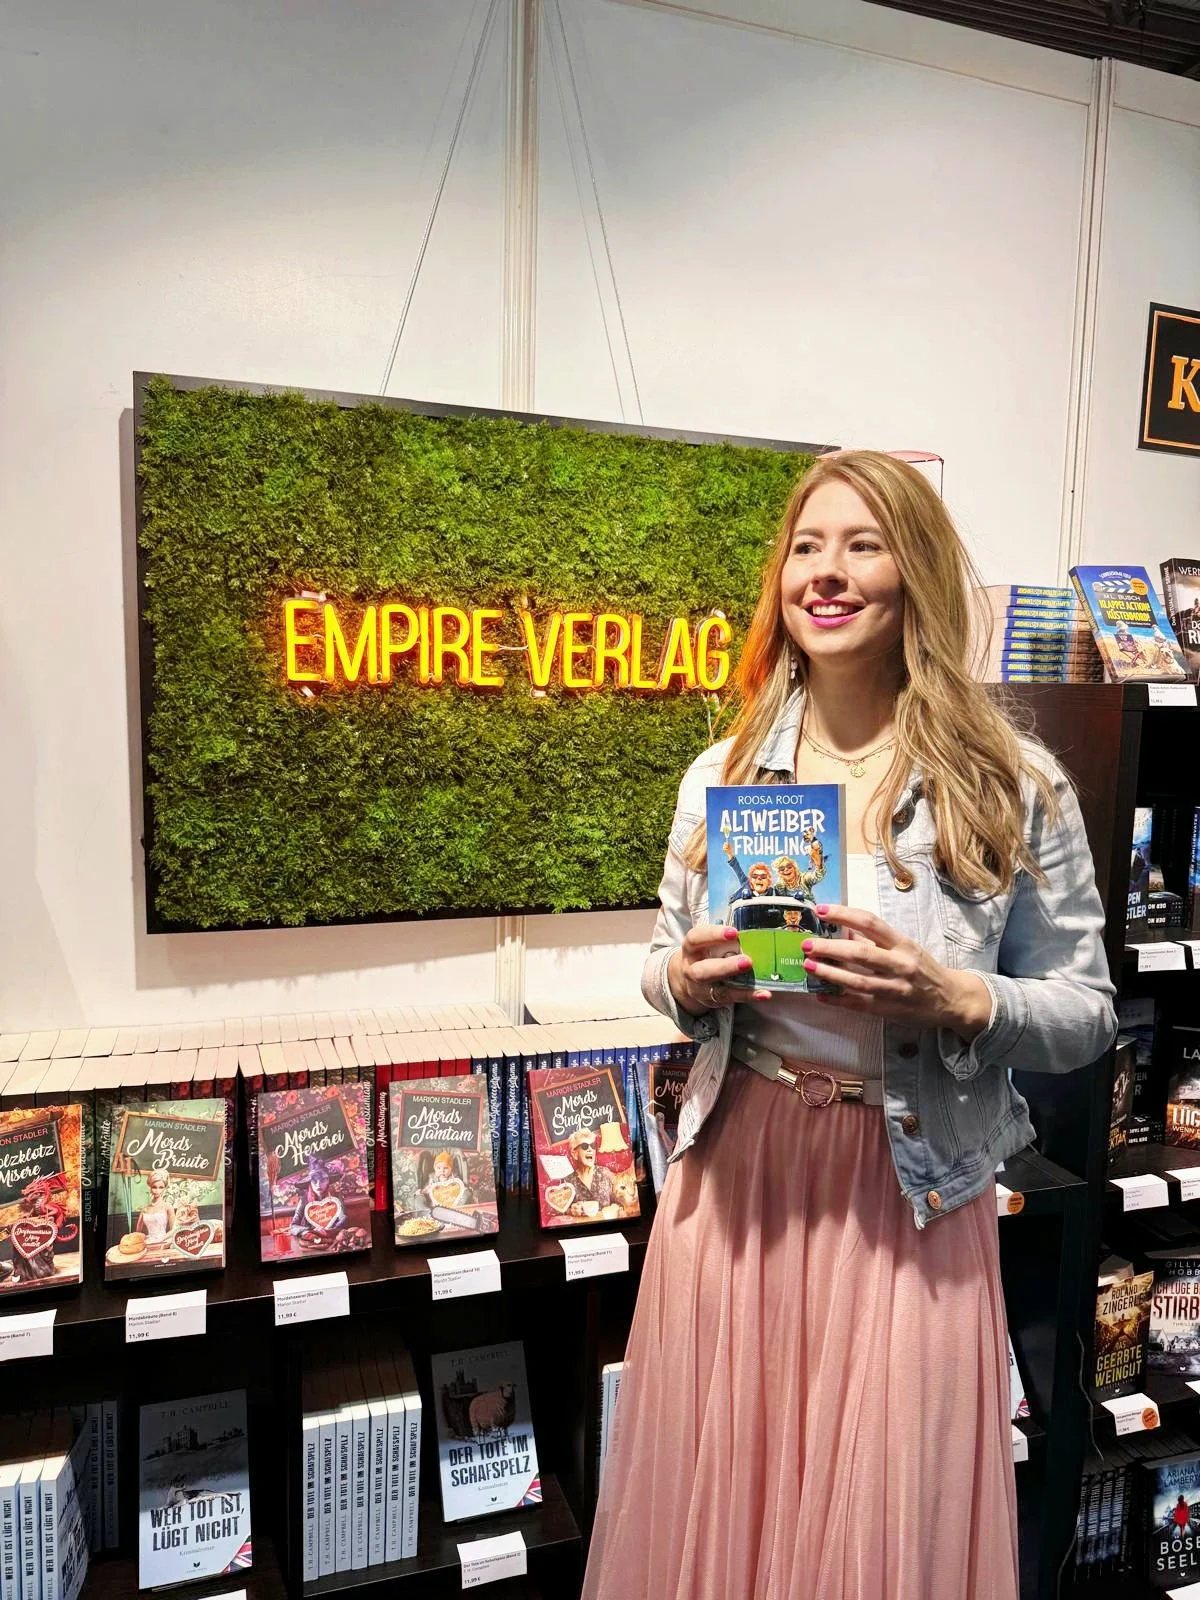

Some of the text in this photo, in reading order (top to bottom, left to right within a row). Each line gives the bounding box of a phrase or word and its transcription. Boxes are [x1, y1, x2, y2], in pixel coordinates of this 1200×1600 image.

[284, 599, 732, 691] EMPIRE VERLAG
[738, 794, 805, 805] ROOSA ROOT
[719, 809, 825, 833] ALTWEIBER
[780, 957, 803, 967] ROMAN
[412, 1095, 472, 1106] MARION STADLER
[547, 1076, 602, 1098] MARION STADLER
[554, 1089, 598, 1119] Mords
[144, 1119, 207, 1133] MARION STADLER
[271, 1103, 332, 1136] MARION STADLER
[408, 1105, 463, 1131] Mords
[552, 1103, 614, 1136] SingSang
[13, 1127, 49, 1143] STADLER
[126, 1128, 193, 1157] Mords
[275, 1121, 329, 1159] Mords
[411, 1122, 474, 1147] Tamtam
[151, 1150, 210, 1171] Bräute
[291, 1129, 346, 1168] Hexerei
[1111, 1284, 1138, 1300] ROLAND
[1170, 1279, 1190, 1295] LÜGE
[1102, 1293, 1144, 1316] ZINGERLE
[1096, 1344, 1143, 1372] GEERBTE
[1095, 1359, 1143, 1388] WEINGUT
[448, 1434, 530, 1467] DER TOTE IM
[450, 1454, 532, 1488] SCHAFSPELZ
[150, 1491, 246, 1529] WER TOT IST,
[152, 1515, 241, 1552] LÜGT NICHT
